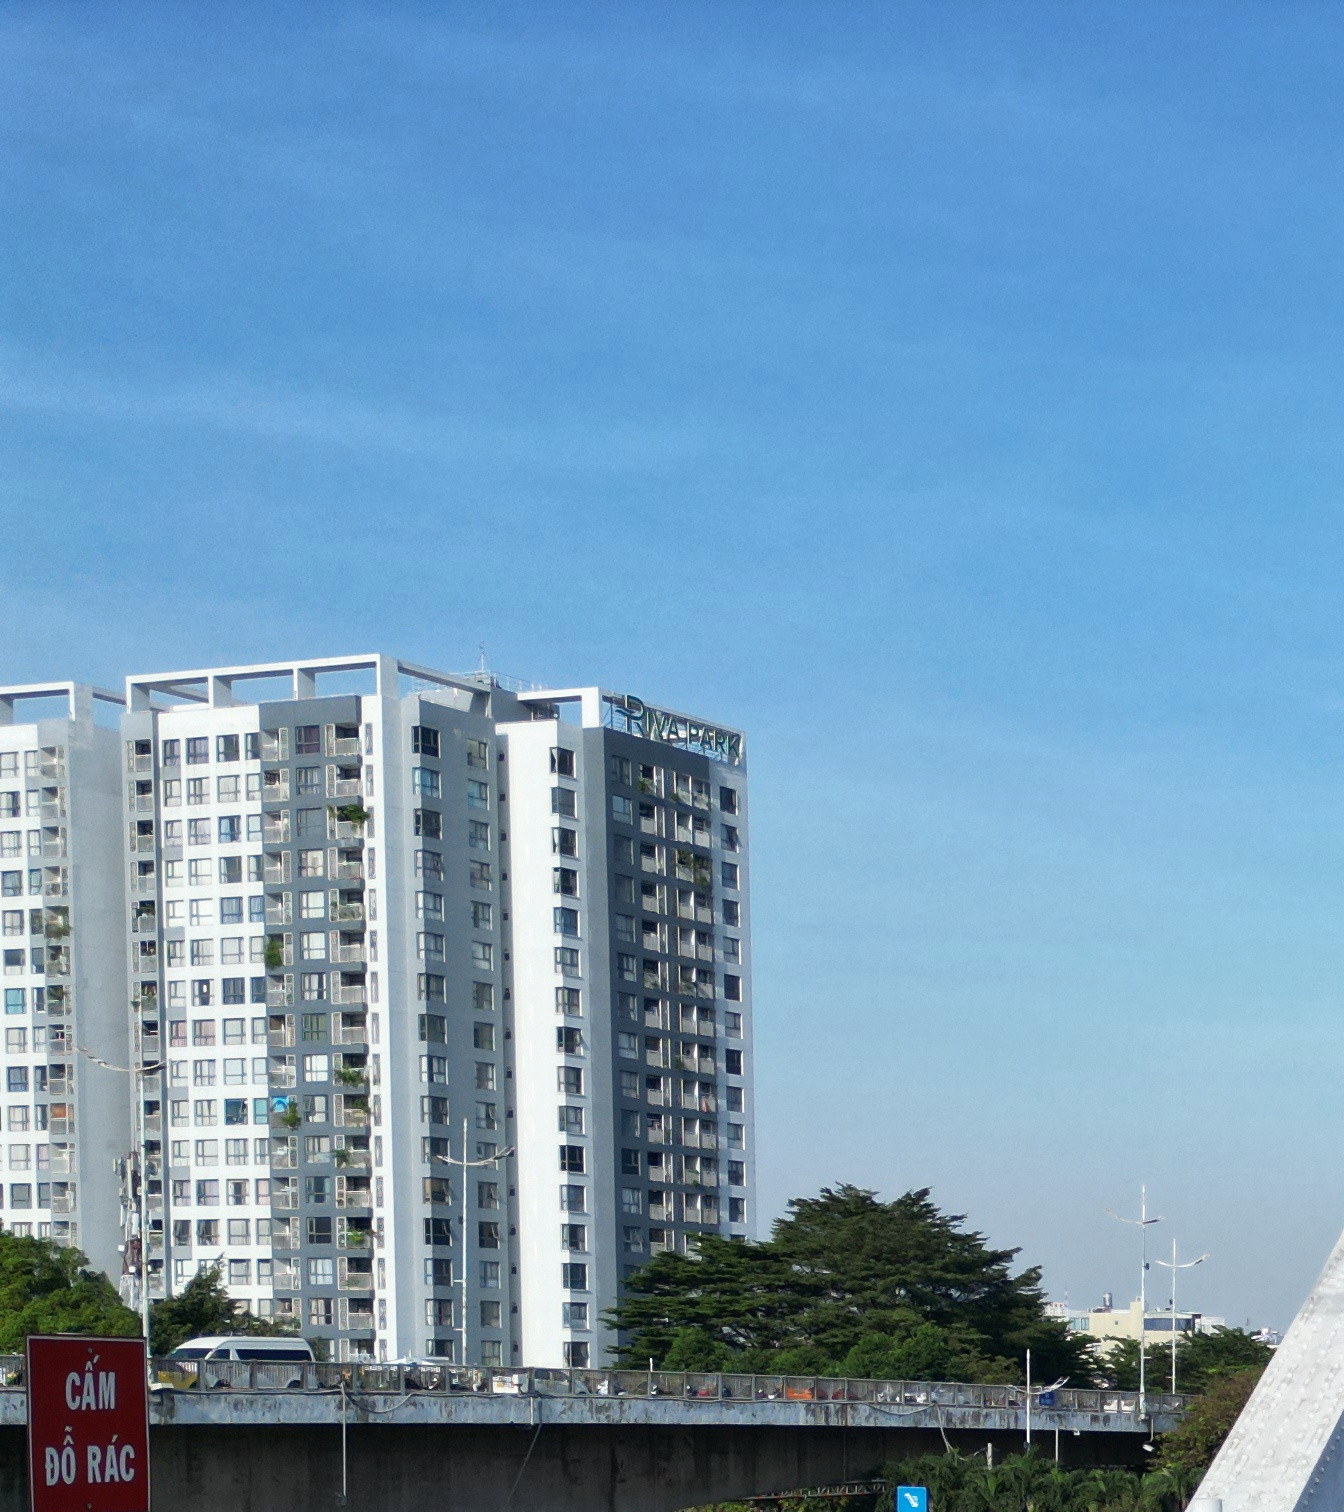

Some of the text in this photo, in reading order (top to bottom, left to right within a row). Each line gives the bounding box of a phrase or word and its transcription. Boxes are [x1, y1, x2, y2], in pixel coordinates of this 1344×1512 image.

[615, 694, 740, 758] RIVA PARK
[65, 1354, 116, 1411] CẤM
[87, 1434, 135, 1484] RÁC
